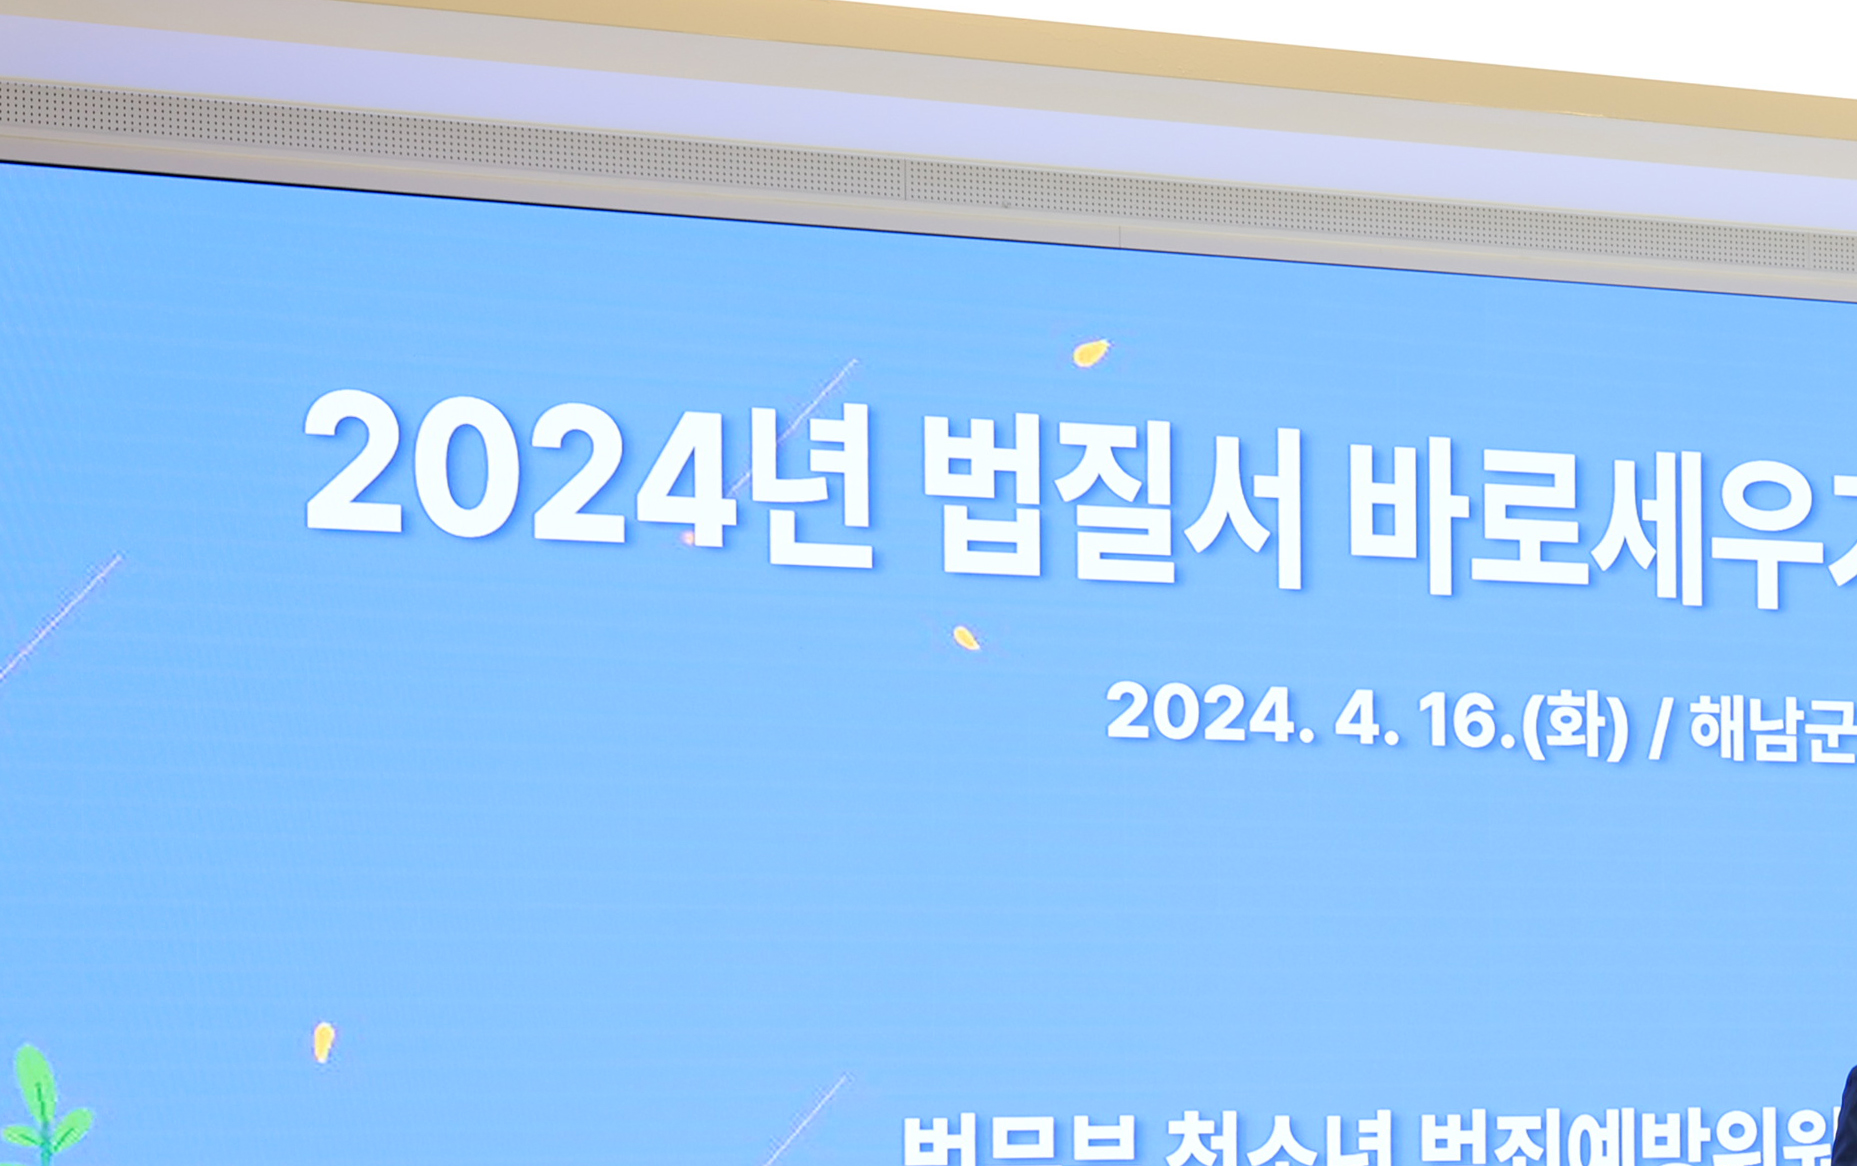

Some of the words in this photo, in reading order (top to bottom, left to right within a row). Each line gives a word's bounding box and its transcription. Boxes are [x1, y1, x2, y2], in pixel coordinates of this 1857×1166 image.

[304, 388, 873, 569] 2024년
[924, 412, 1302, 590] 법질서
[1106, 681, 1314, 743] 2024.
[1335, 689, 1399, 746] 4.
[1419, 689, 1628, 763] 16.(화)
